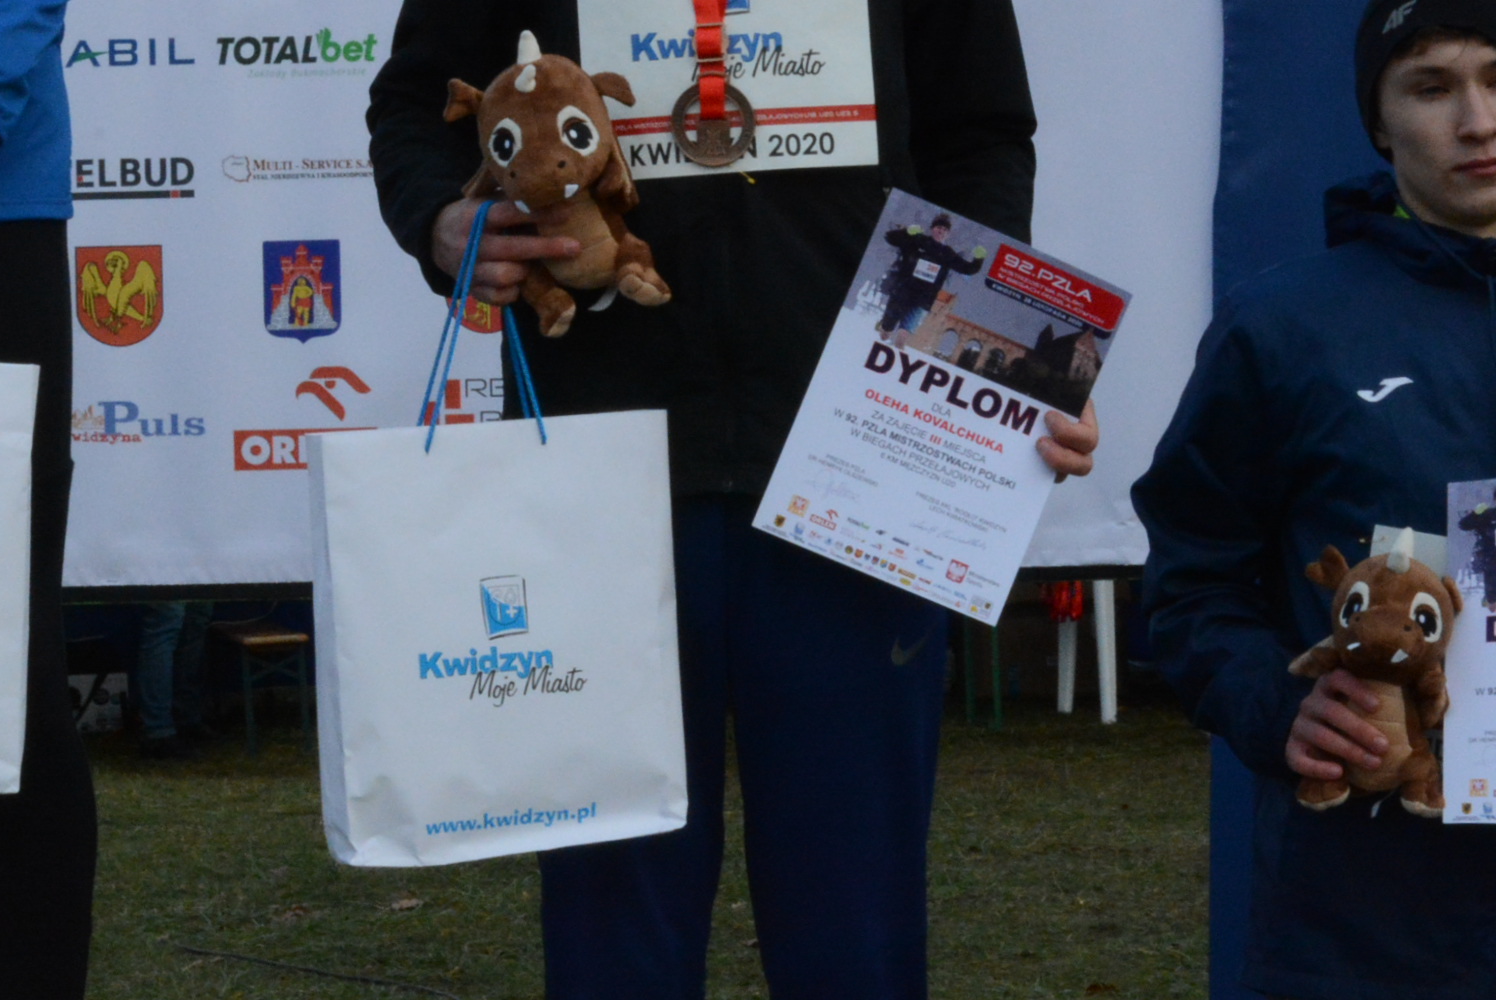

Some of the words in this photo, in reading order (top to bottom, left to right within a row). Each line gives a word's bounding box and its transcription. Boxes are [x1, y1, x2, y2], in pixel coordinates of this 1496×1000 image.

[65, 37, 195, 68] ABIL
[217, 27, 378, 65] TOTALbet
[630, 28, 783, 63] Kwizyn
[752, 46, 825, 78] Miasto
[768, 132, 835, 157] 2020
[76, 157, 195, 188] ELBUD
[465, 378, 504, 398] RE
[864, 341, 1040, 436] DYPLOM
[98, 400, 206, 437] Puls
[931, 402, 951, 418] DLA
[71, 431, 142, 445] widzyna
[913, 408, 1004, 454] KOVALCHUKA
[861, 420, 888, 437] PZLA
[979, 467, 1016, 490] POLSKI
[419, 646, 554, 680] Kwidzyn
[469, 672, 518, 707] Moje
[523, 665, 587, 697] Miasto
[425, 802, 597, 836] www.kwidzyn.pl
